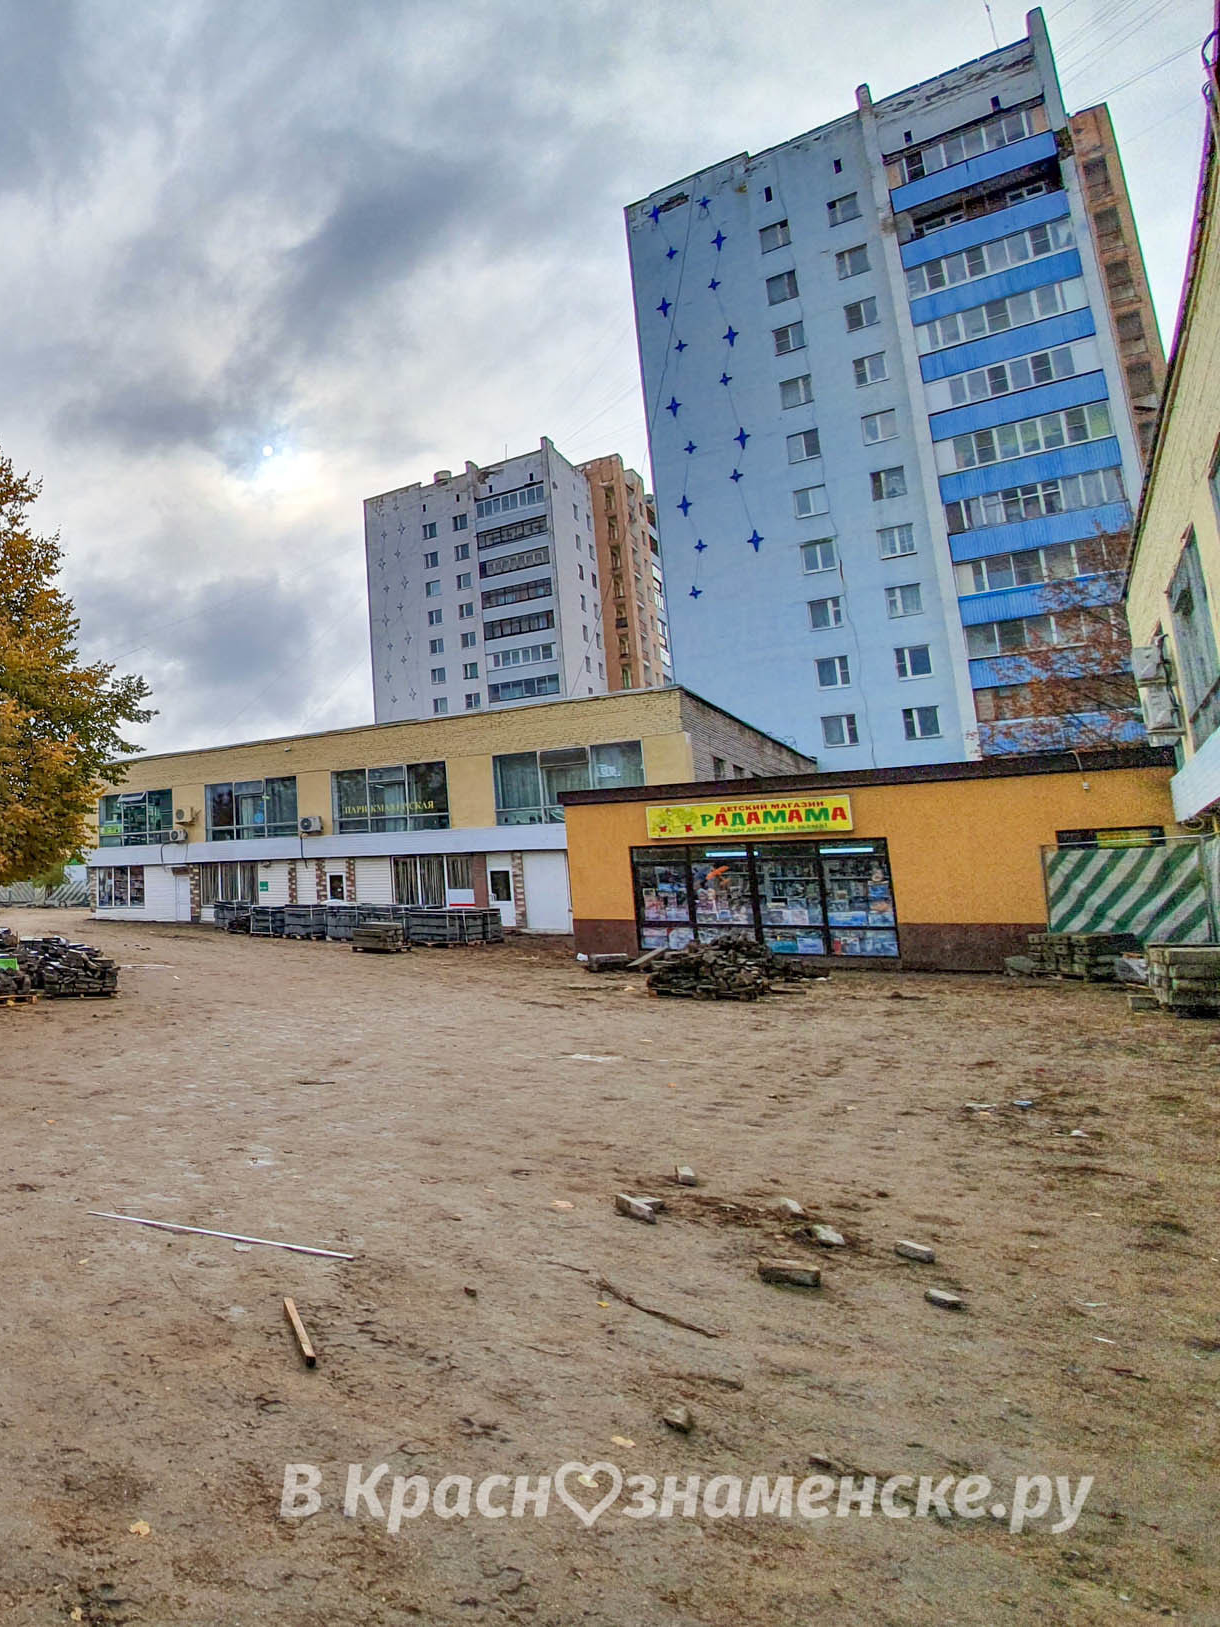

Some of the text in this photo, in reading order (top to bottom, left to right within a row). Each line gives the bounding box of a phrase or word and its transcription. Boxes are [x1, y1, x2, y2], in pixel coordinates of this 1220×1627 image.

[344, 800, 435, 814] ПАРИКМСКАЯ
[720, 801, 824, 813] ДЕТСКИЙ МАГАЗИН
[700, 807, 847, 827] РАДАМАМА
